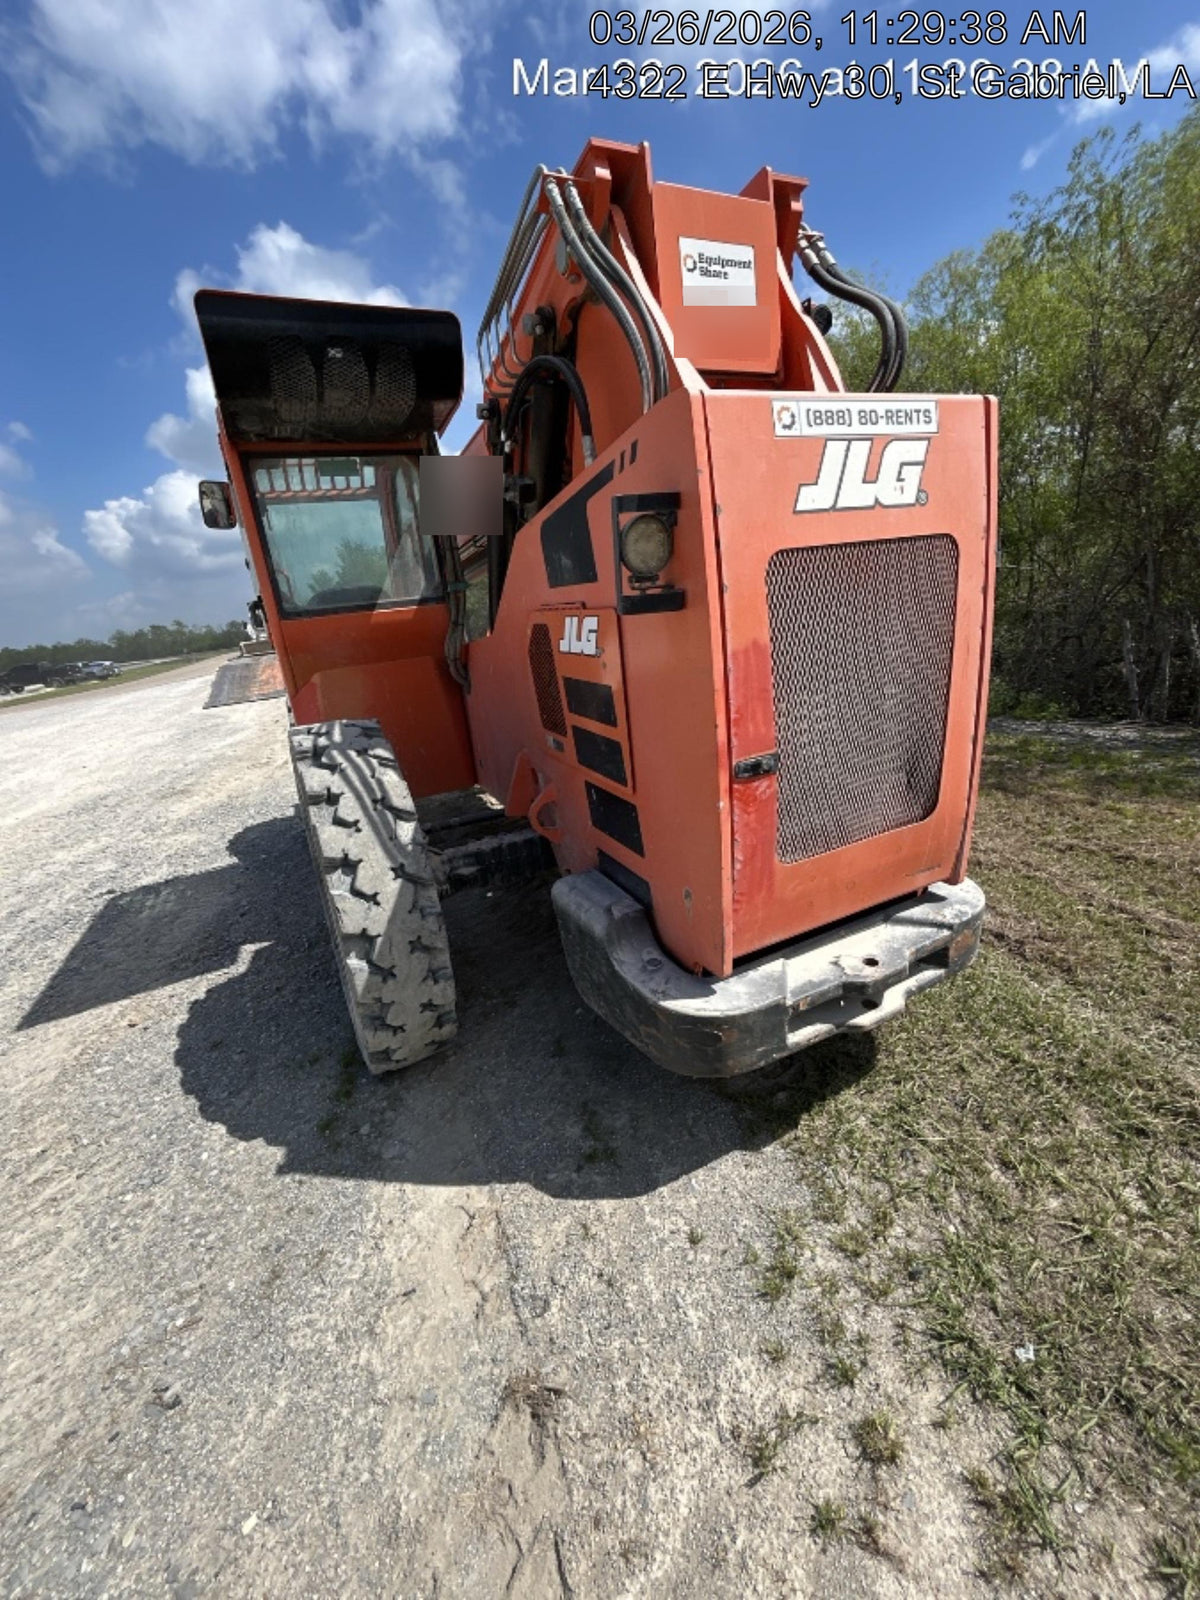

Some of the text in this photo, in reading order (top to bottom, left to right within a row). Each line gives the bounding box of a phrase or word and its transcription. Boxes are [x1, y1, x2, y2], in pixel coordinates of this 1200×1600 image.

[698, 252, 752, 270] Equipment
[699, 266, 729, 280] Share
[806, 408, 933, 428] (888) 80-RENTS
[793, 438, 931, 514] JLG
[558, 614, 600, 658] JLG
